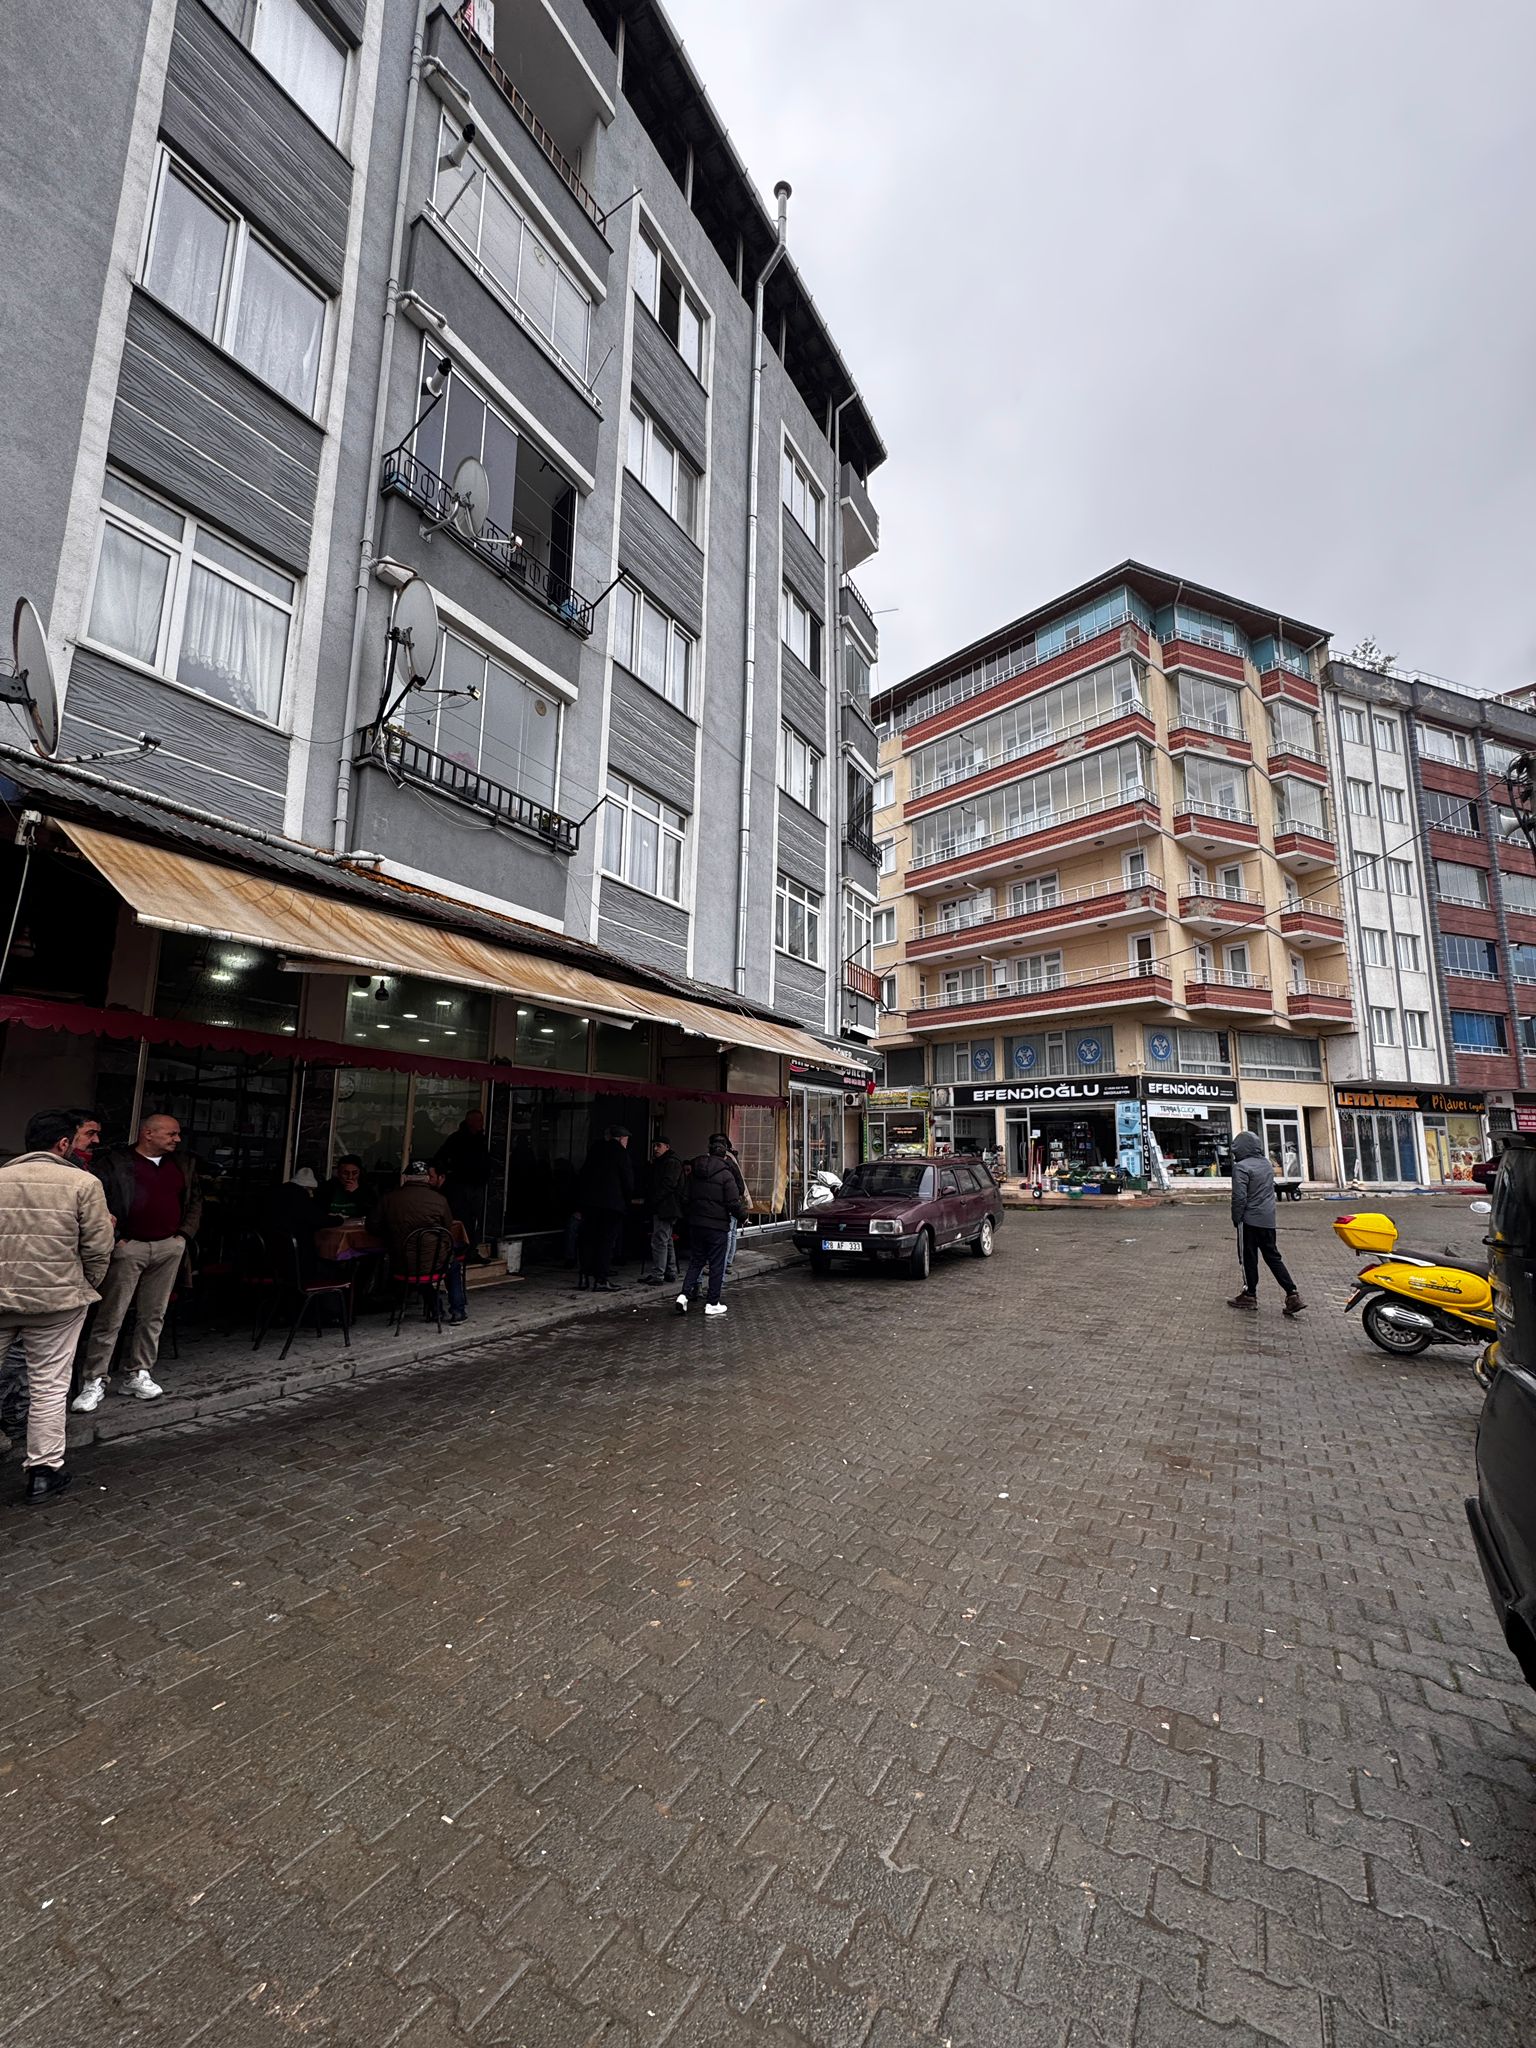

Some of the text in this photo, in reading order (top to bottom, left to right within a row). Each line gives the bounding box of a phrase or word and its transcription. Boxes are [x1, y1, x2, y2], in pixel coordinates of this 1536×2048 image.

[973, 1083, 1100, 1101] EFENDİOĞLU
[1148, 1082, 1219, 1096] EFENDİOĞLU
[1337, 1090, 1420, 1108] LEYDİ YEMEK
